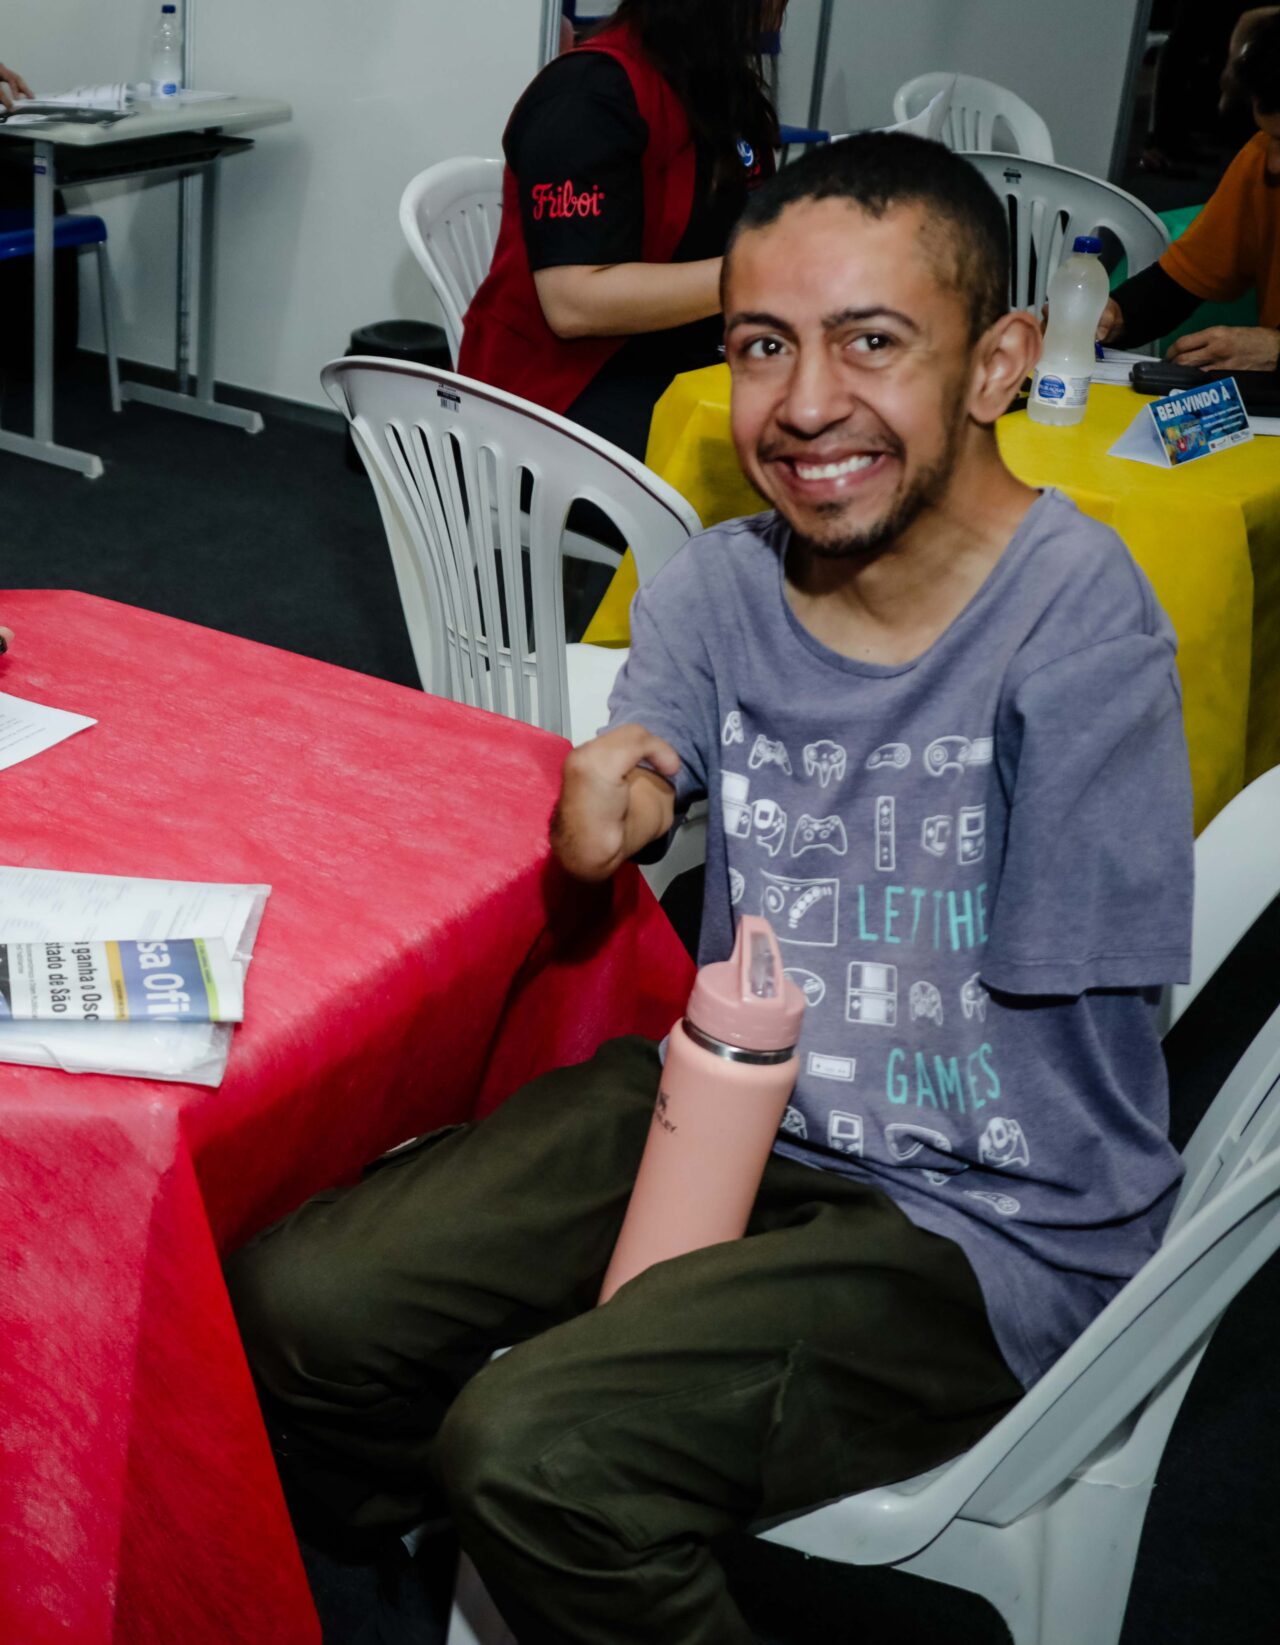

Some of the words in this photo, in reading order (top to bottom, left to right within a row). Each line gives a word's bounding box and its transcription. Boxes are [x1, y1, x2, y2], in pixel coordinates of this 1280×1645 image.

[531, 180, 604, 220] Friboi
[1156, 388, 1220, 421] BEM-VINDO
[857, 884, 926, 944] LET
[932, 882, 989, 951] THE
[72, 948, 99, 983] ganha
[136, 940, 171, 969] sa
[49, 973, 68, 986] de
[143, 973, 191, 1020] Ofi
[51, 988, 71, 1013] São
[886, 1042, 1001, 1114] GAMES
